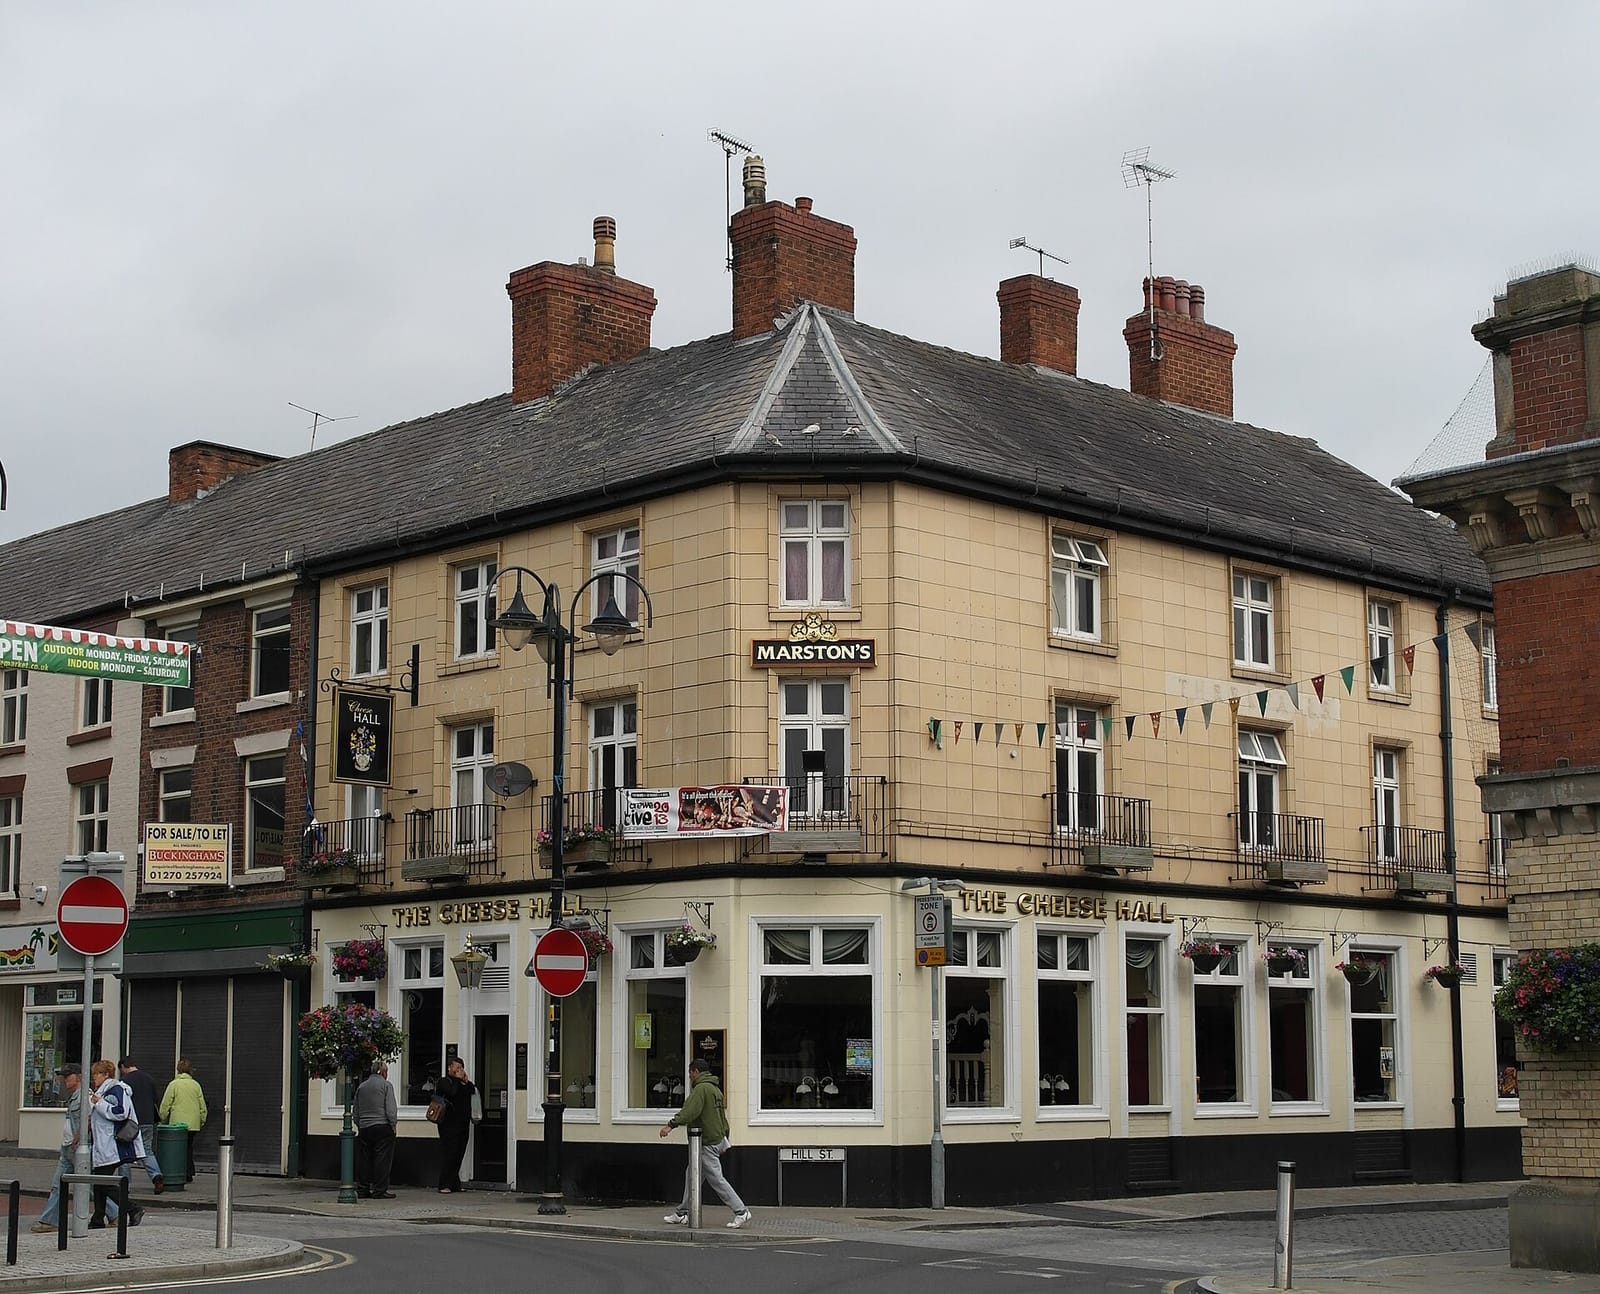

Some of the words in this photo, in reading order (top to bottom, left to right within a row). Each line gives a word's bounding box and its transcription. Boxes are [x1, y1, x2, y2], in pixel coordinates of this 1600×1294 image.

[43, 643, 85, 656] OUTDOOR
[85, 648, 122, 662] MONDAY,
[124, 653, 151, 666] FRIDAY,
[153, 656, 188, 669] SATURDAY
[757, 643, 871, 660] MARSTON'S
[67, 658, 100, 671] INDOOR
[101, 662, 136, 674] MONDAY
[143, 666, 181, 679] SATURDAY
[347, 700, 373, 714] Cheese
[353, 711, 381, 725] HALL
[653, 801, 669, 813] 20
[653, 813, 669, 825] 13
[148, 827, 167, 839] FOR
[170, 827, 210, 841] SALE/TO
[213, 828, 227, 840] LET
[149, 850, 225, 861] BUCKINGHAMS
[150, 871, 182, 880] 01270
[185, 872, 222, 880] 257924
[920, 902, 939, 910] ZONE
[960, 889, 1006, 913] THE
[1017, 893, 1107, 919] CHEESE
[1116, 899, 1175, 923] HALL
[392, 906, 431, 928] THE
[439, 900, 520, 924] CHEESE
[791, 1149, 813, 1159] HILL
[819, 1149, 834, 1159] ST.
